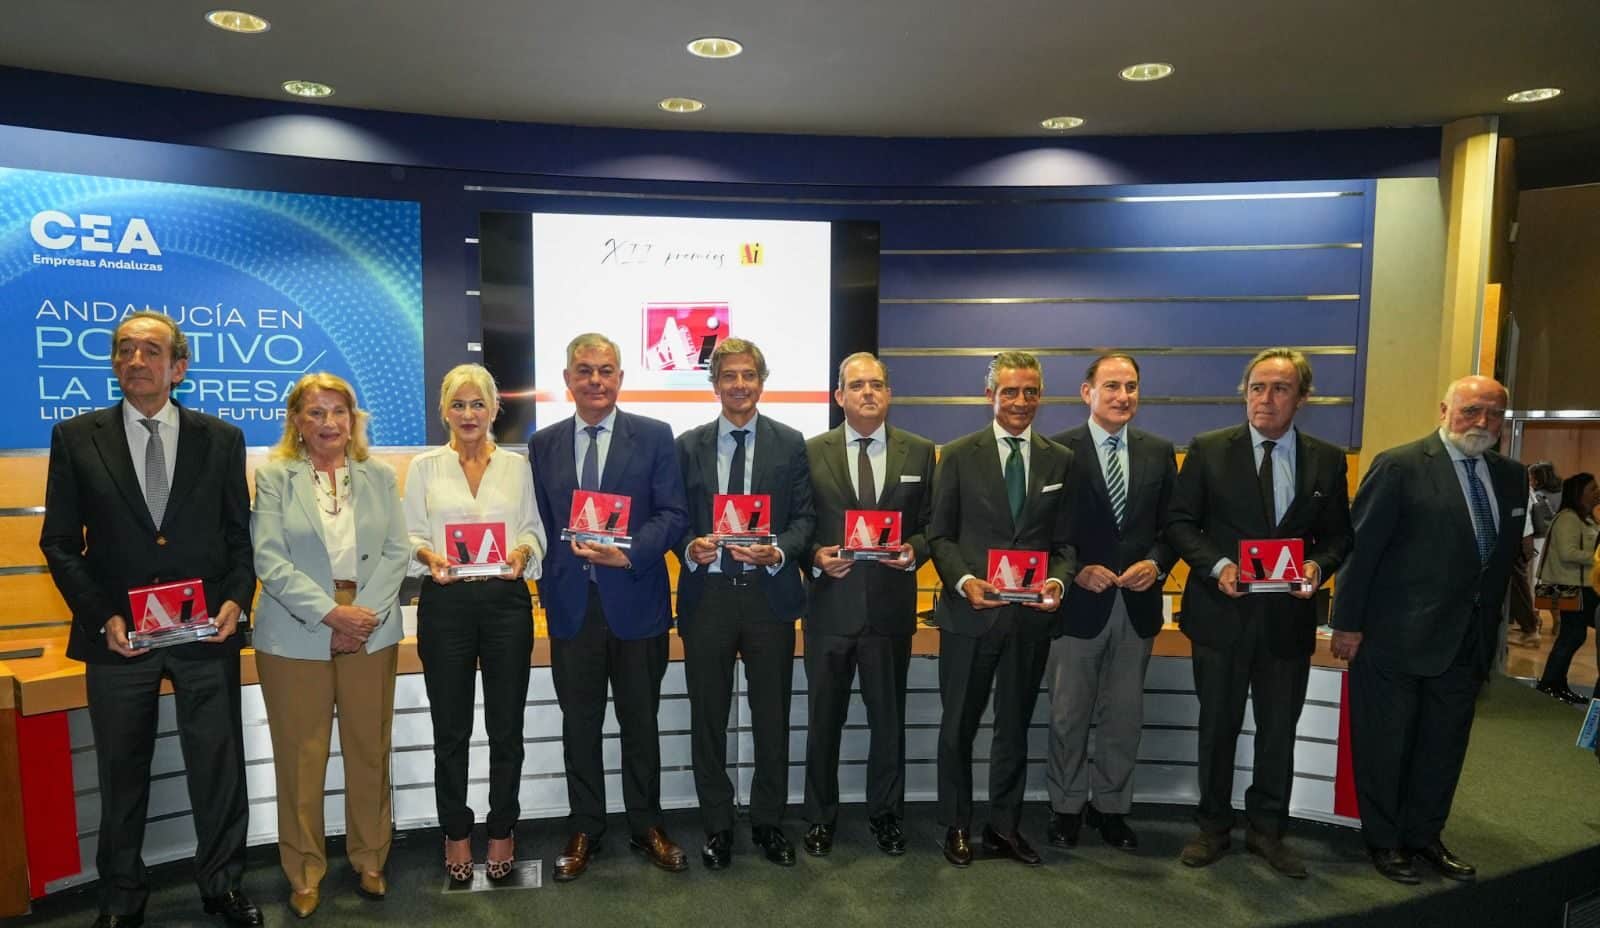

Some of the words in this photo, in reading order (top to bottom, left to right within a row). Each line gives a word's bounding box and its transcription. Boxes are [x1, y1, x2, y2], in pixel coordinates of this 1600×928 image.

[30, 210, 162, 256] CEA
[33, 254, 96, 267] Empresas
[99, 258, 163, 271] Andaluzas
[258, 309, 303, 329] EN
[35, 326, 303, 365] POTIVO
[39, 376, 91, 400] LA
[107, 377, 296, 402] EPRESA
[218, 407, 288, 420] FUTUR
